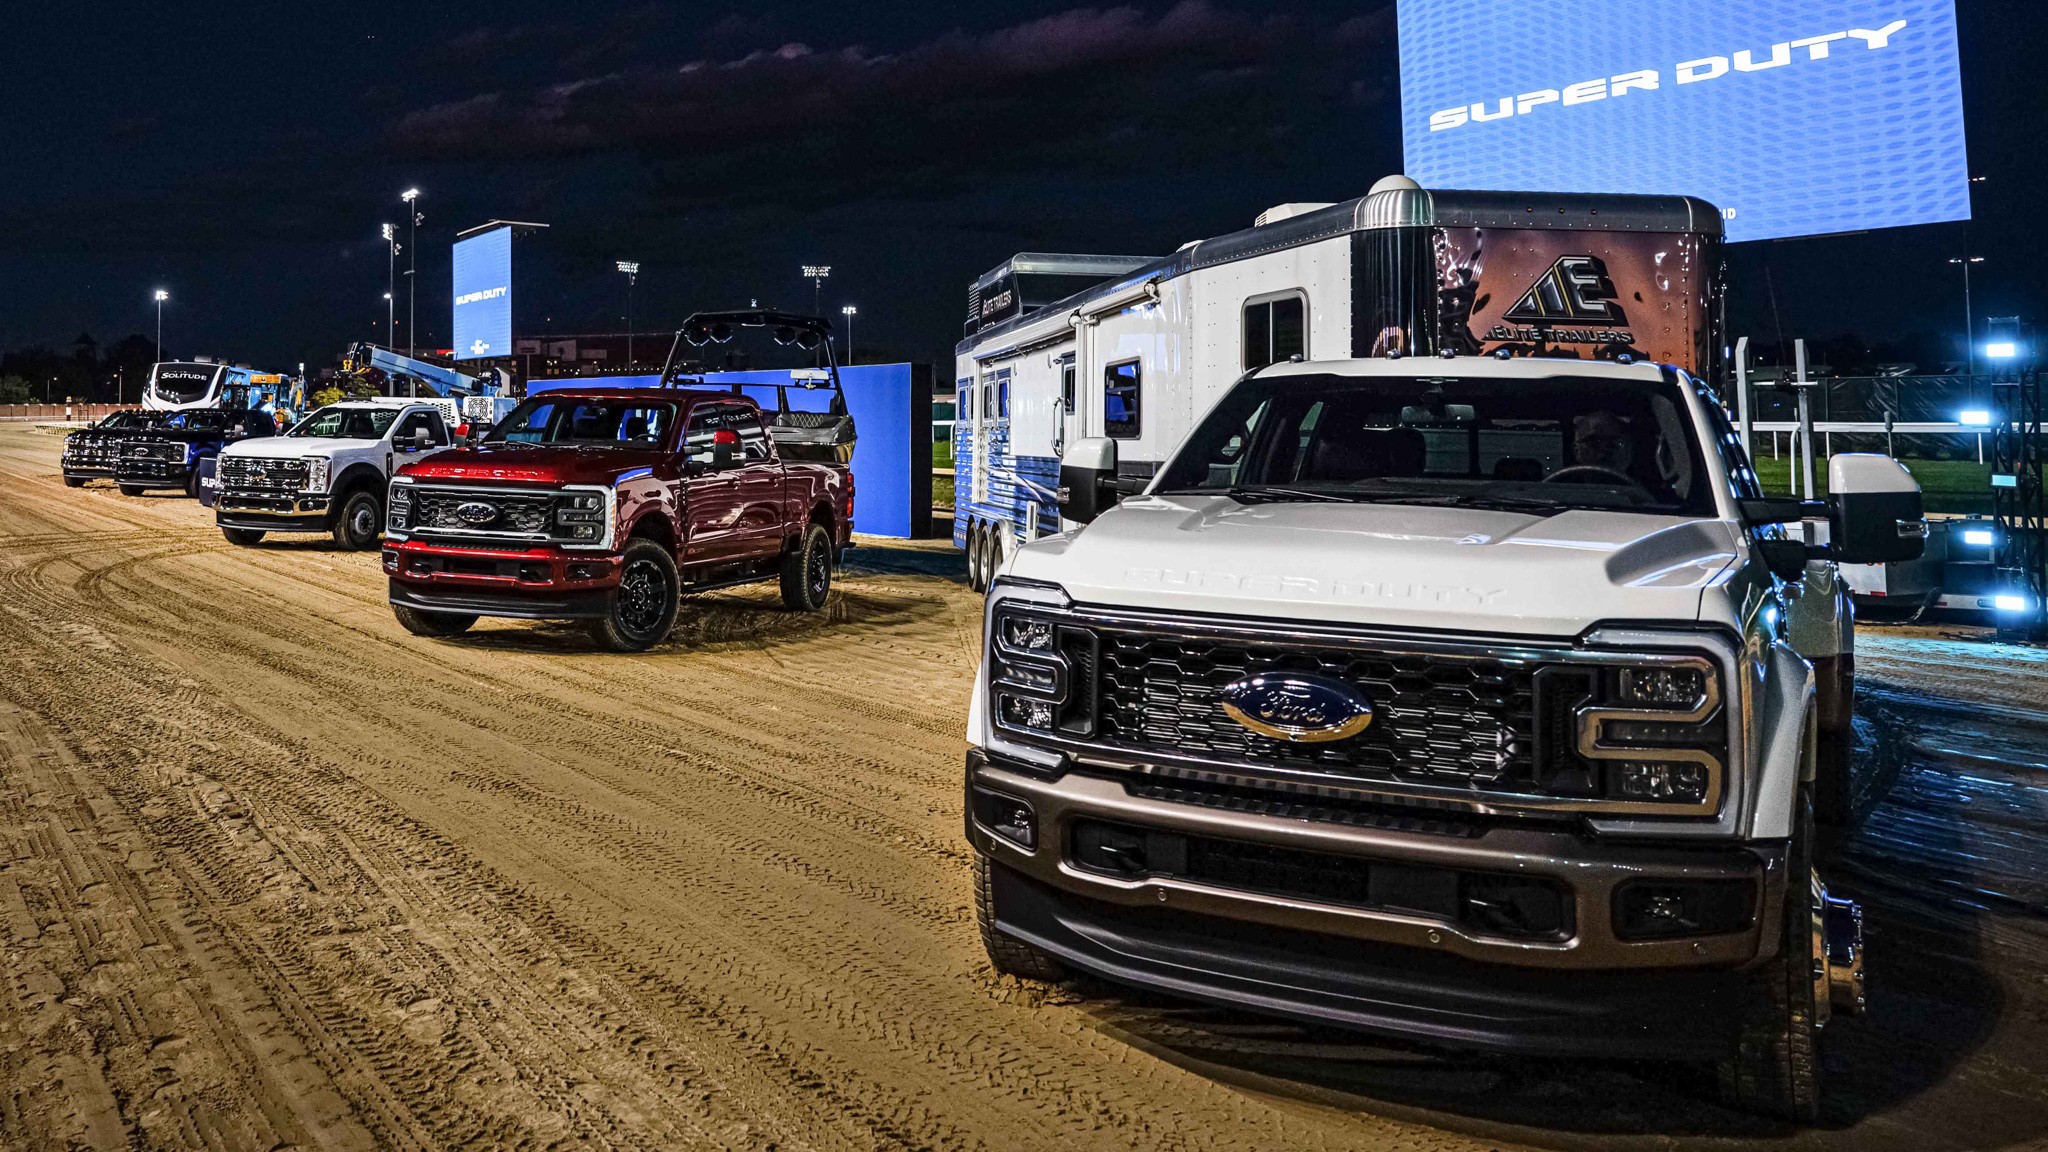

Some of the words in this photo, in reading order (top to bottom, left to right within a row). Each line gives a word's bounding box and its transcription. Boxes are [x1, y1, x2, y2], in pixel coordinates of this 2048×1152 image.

[1429, 69, 1659, 132] SUPER
[1675, 19, 1907, 85] DUTY
[1719, 208, 1737, 220] ID
[483, 286, 507, 300] DUTY
[1543, 328, 1632, 343] TRAILERS
[161, 372, 207, 381] SOLITUDE
[201, 477, 216, 488] SUP
[1123, 566, 1318, 594] SUPER
[1332, 579, 1508, 605] DUTY
[1259, 690, 1326, 723] Ford
